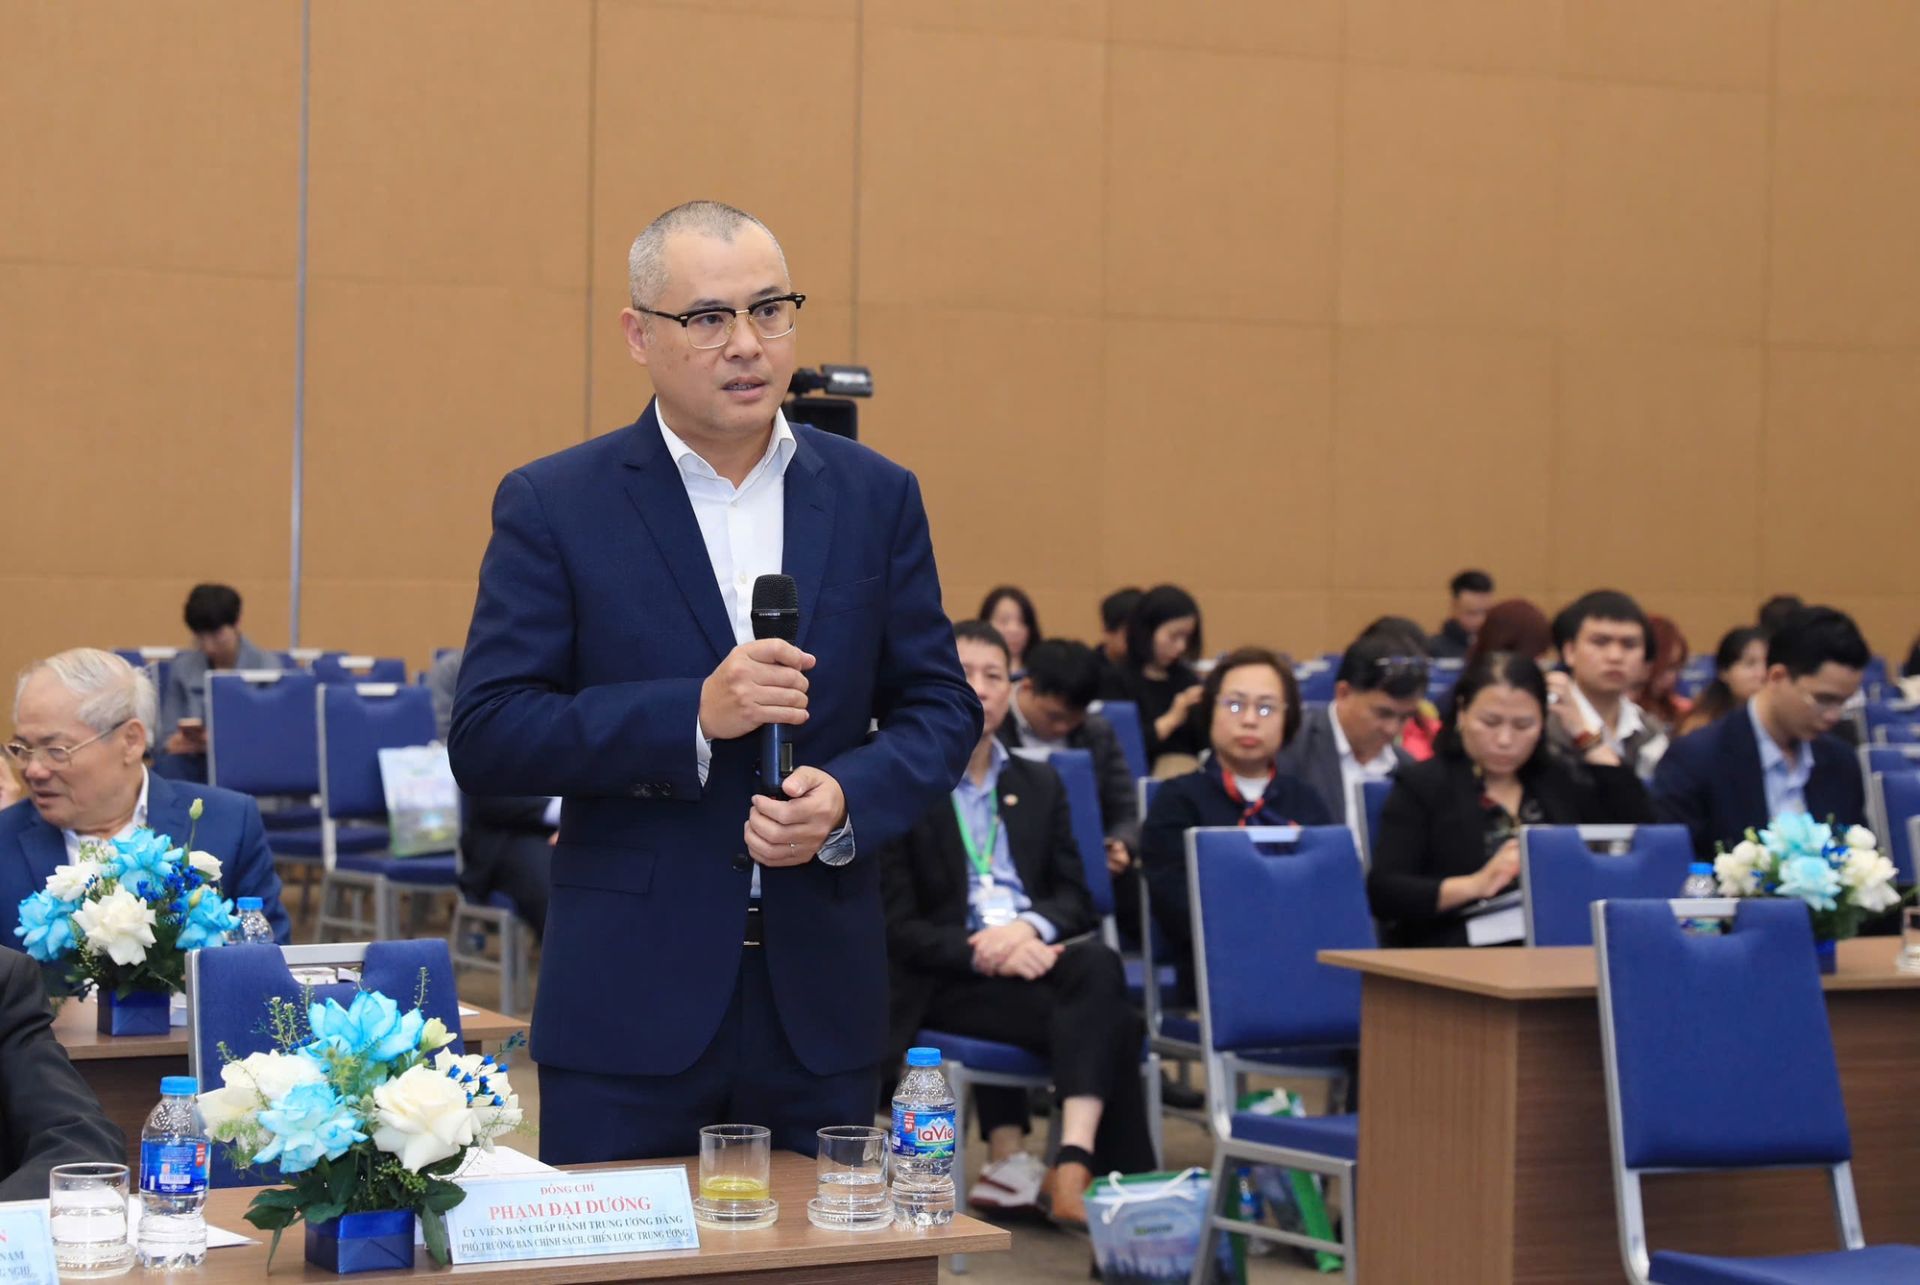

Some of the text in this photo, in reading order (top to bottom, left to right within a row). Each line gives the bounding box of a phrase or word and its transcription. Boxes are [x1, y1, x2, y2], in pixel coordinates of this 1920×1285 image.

[489, 1196, 651, 1221] PHẠM ĐẠI DƯƠNG
[506, 1224, 526, 1235] BAN
[590, 1219, 622, 1229] TRUNG
[516, 1238, 534, 1249] BAN
[638, 1230, 664, 1241] TRUNG
